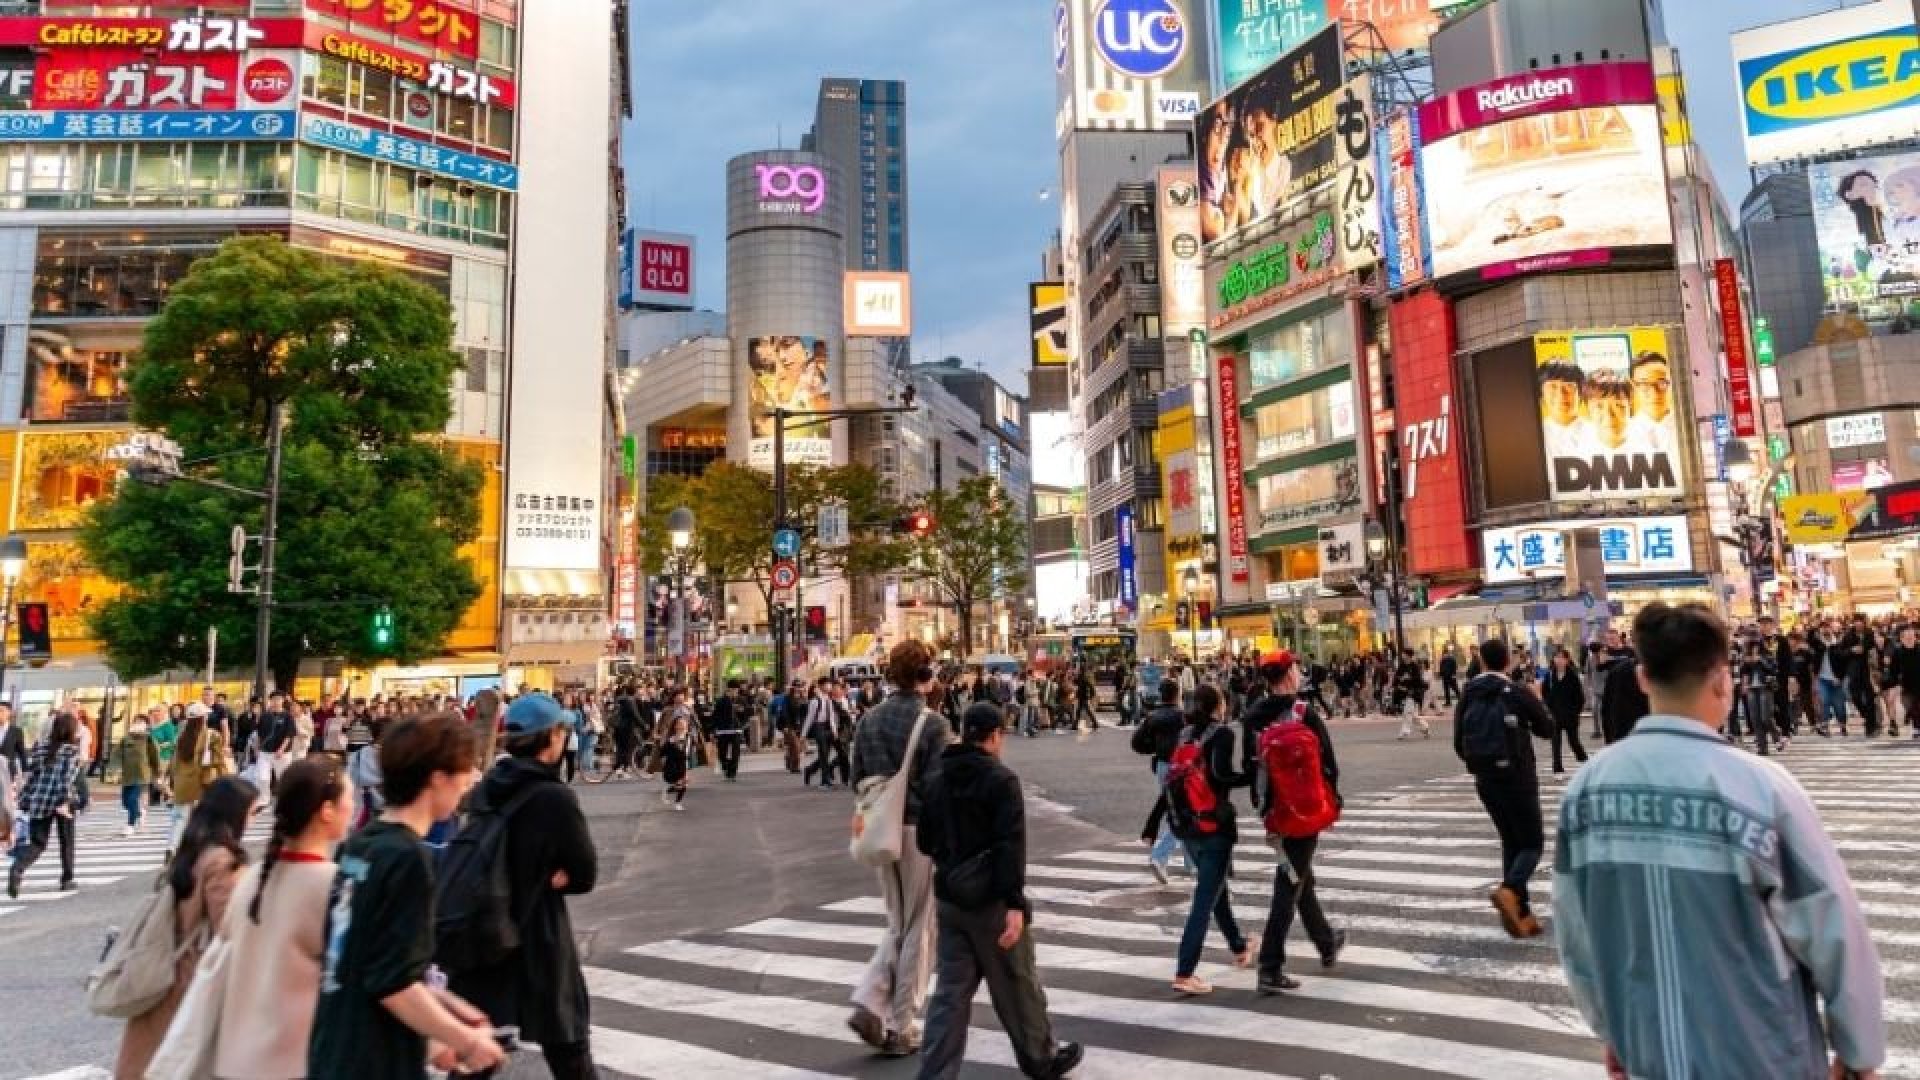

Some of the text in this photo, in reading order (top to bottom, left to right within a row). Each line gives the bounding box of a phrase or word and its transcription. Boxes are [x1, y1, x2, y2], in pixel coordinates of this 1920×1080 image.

[168, 17, 265, 50] ガスト
[1103, 9, 1181, 54] UC
[45, 69, 99, 89] Café
[103, 63, 226, 106] ガスト
[251, 78, 289, 90] ガスト
[426, 60, 501, 104] ガスト
[1477, 76, 1574, 111] Rakuten
[1765, 50, 1920, 108] IKEA
[1157, 98, 1198, 114] VISA
[755, 163, 825, 213] 109
[1336, 88, 1381, 258] もんじゃ
[647, 246, 682, 266] UNI
[648, 267, 683, 288] QLO
[1404, 393, 1450, 499] クスリ
[1553, 452, 1677, 493] DMM
[514, 492, 595, 512] 広告主募集中
